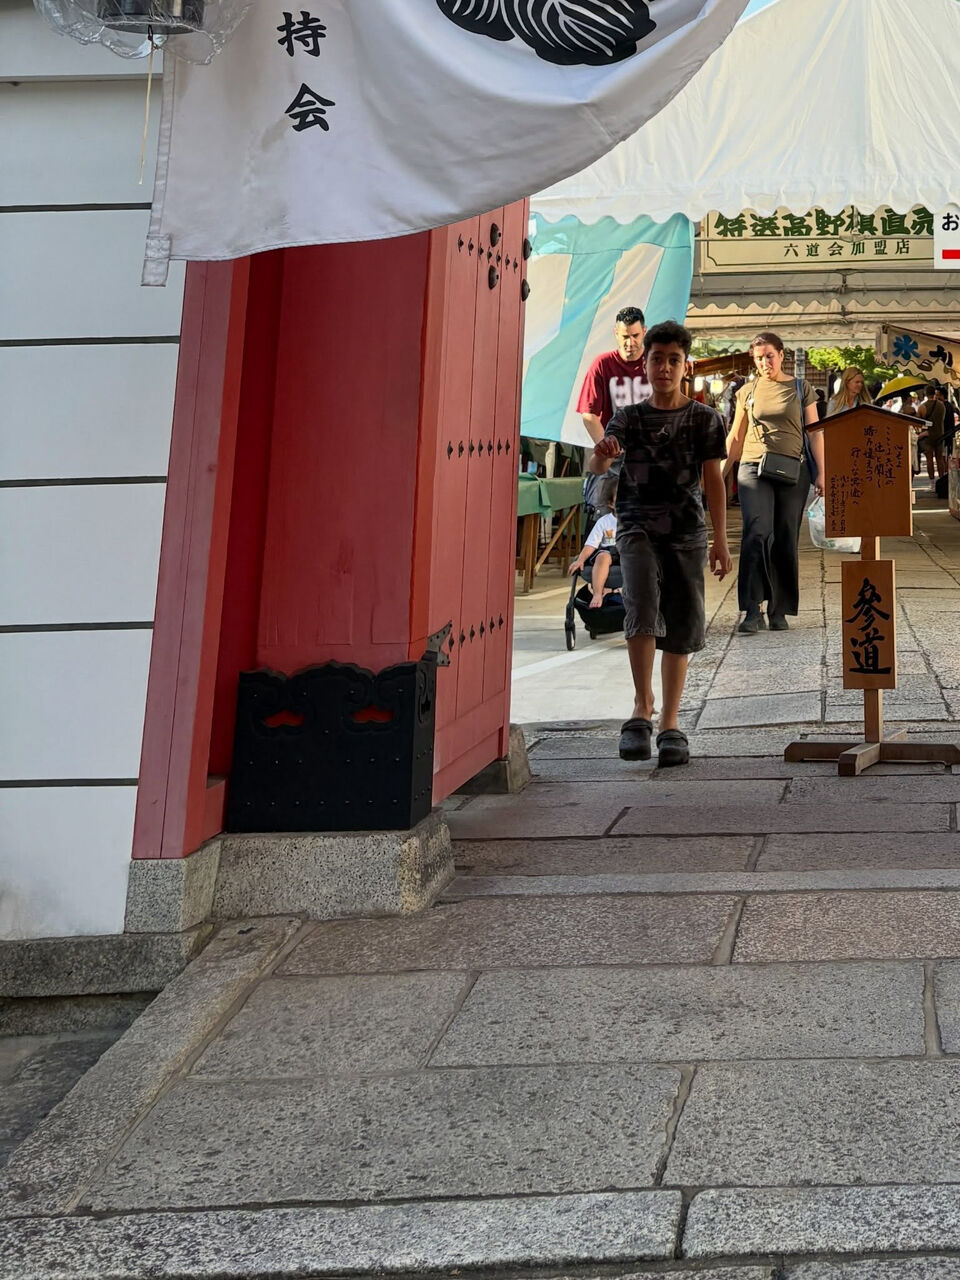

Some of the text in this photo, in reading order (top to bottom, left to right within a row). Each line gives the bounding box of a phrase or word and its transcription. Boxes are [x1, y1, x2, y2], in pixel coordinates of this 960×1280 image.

[783, 239, 911, 258] 六道会加盟店
